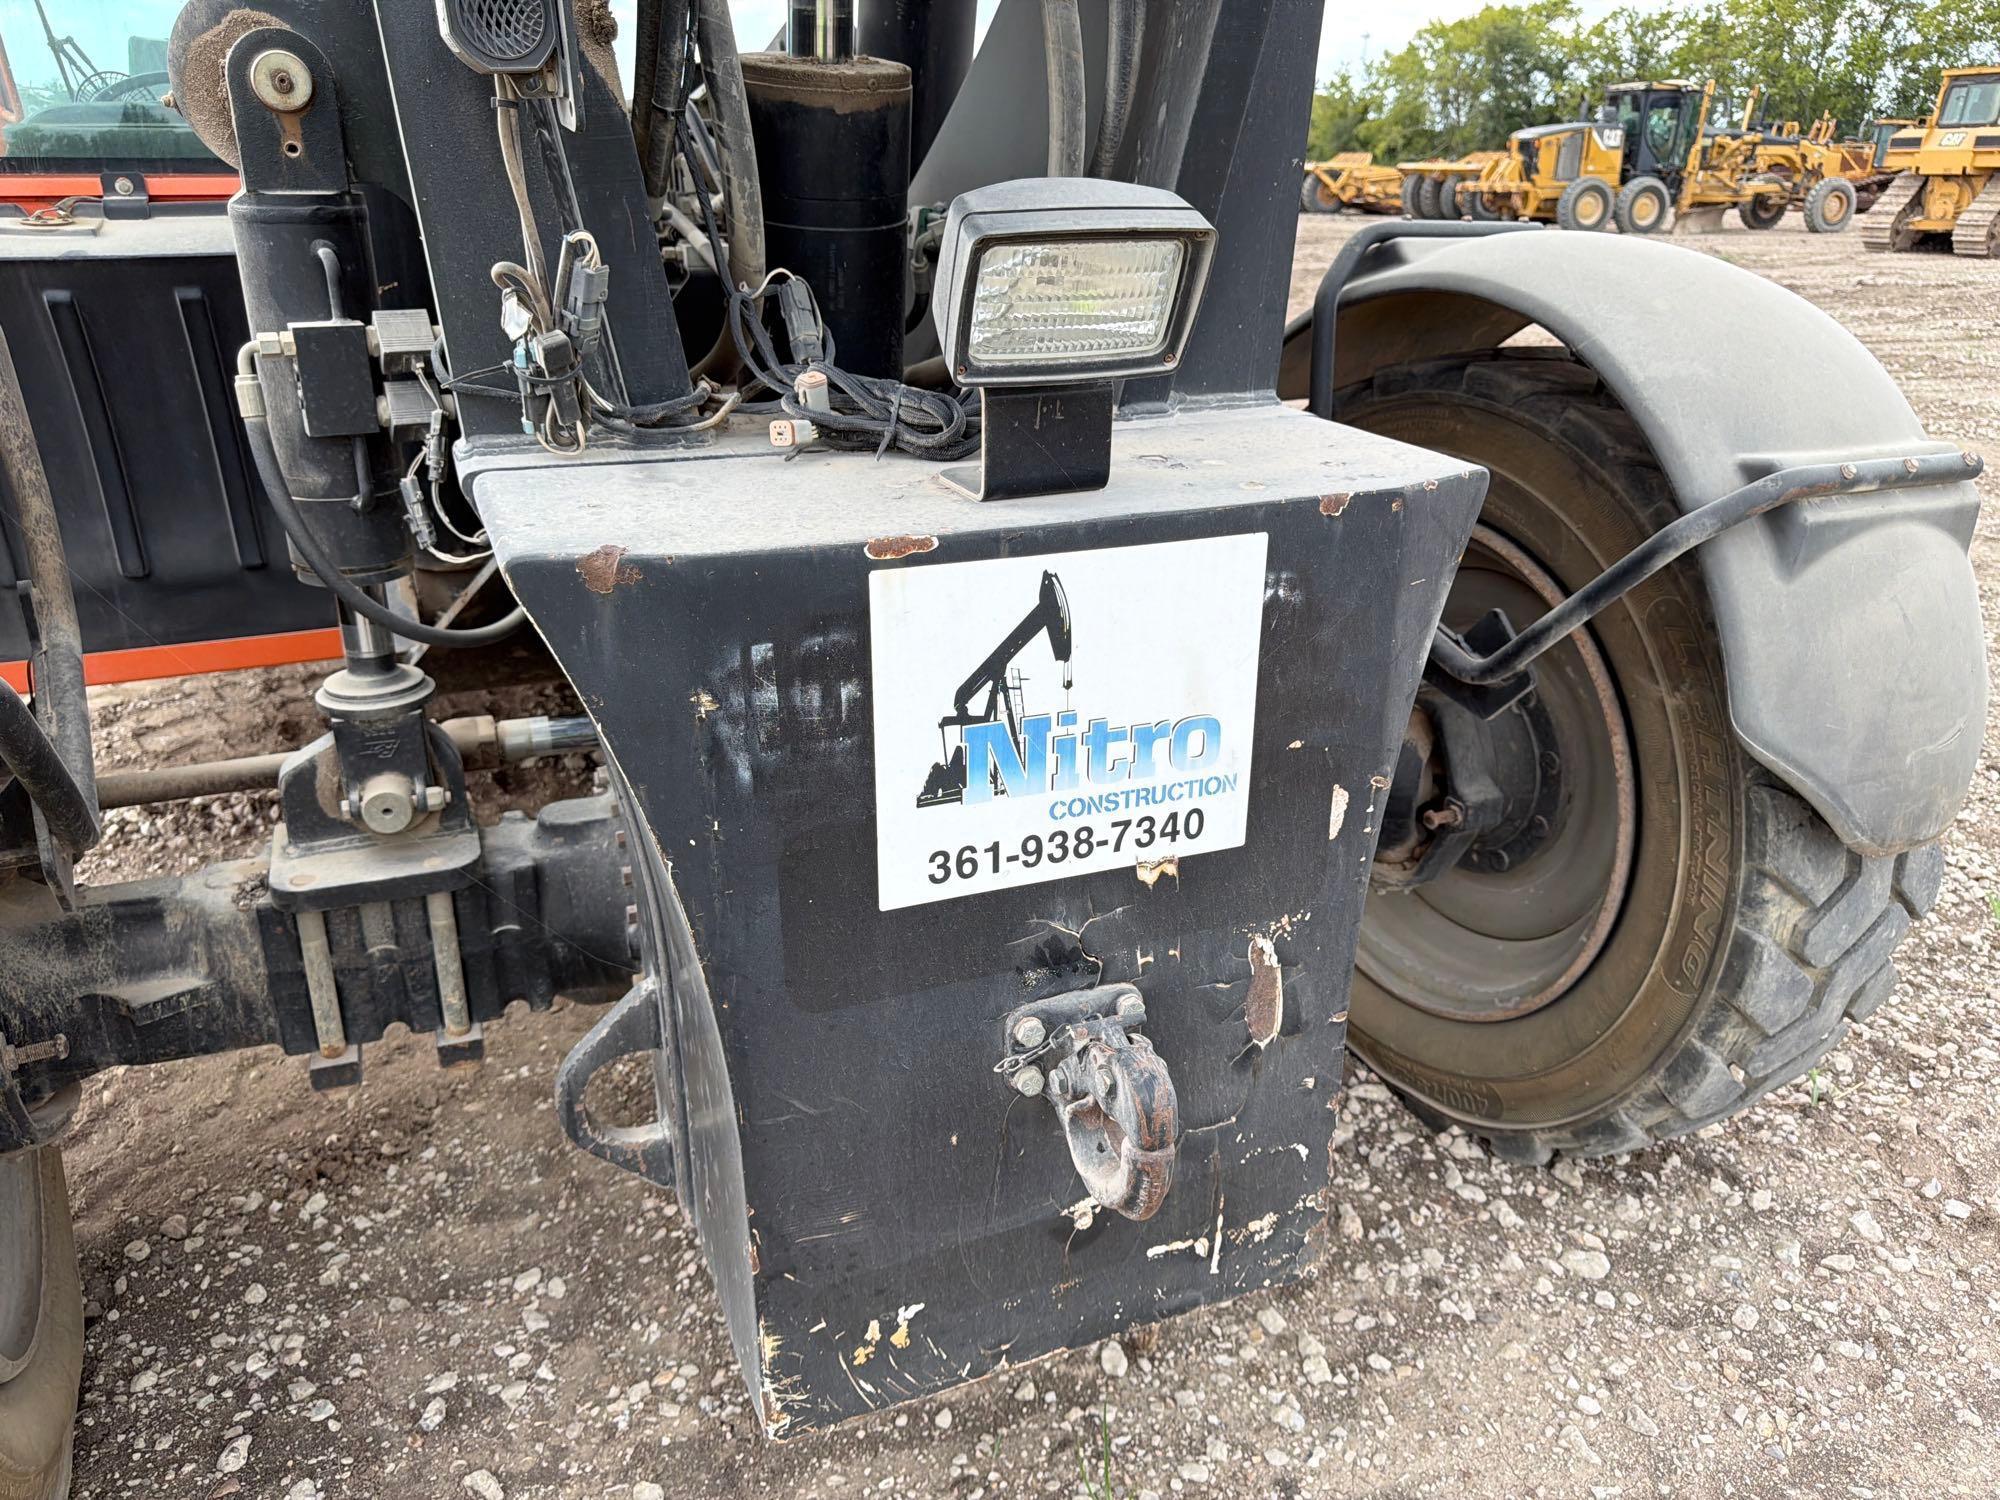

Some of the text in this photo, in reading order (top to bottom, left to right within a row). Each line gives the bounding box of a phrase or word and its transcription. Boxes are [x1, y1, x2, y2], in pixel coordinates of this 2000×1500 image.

[1603, 128, 1623, 147] CAT
[1940, 132, 1967, 146] CAT
[961, 710, 1222, 806] Nitro
[1049, 773, 1238, 821] CONSTRUCTION
[928, 807, 1205, 885] 361-938-7340
